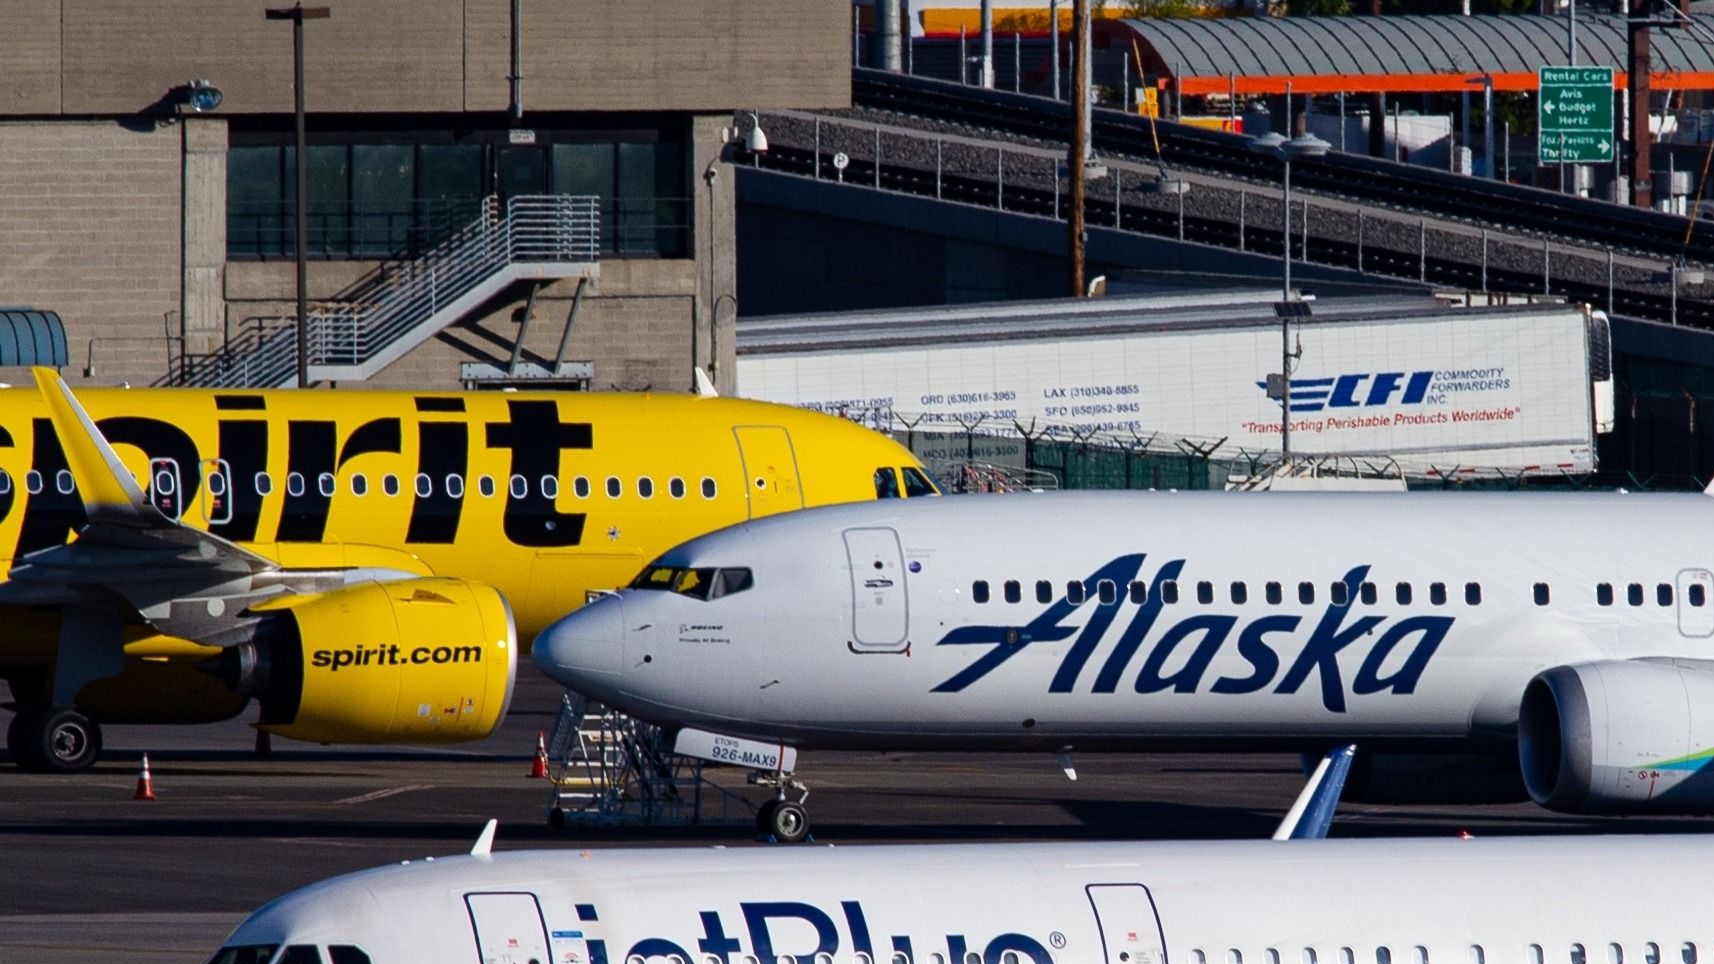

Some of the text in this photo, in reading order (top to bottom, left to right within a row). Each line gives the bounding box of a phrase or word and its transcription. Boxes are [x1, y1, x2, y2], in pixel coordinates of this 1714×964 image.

[1544, 71, 1608, 81] Rental Cars
[1560, 89, 1583, 99] Avis
[1559, 102, 1597, 115] Budget
[1559, 116, 1589, 126] Hertz
[1542, 148, 1580, 161] Thrfty
[1434, 367, 1504, 381] COMMODITY
[1327, 370, 1434, 407] CFI
[1430, 378, 1511, 392] FORWARDERS
[1326, 414, 1391, 430] Perishable
[1394, 410, 1448, 426] Products
[0, 395, 592, 570] pirit
[929, 553, 1456, 714] Alaska
[311, 644, 482, 672] spirit.com
[711, 746, 777, 768] 926-MAX9
